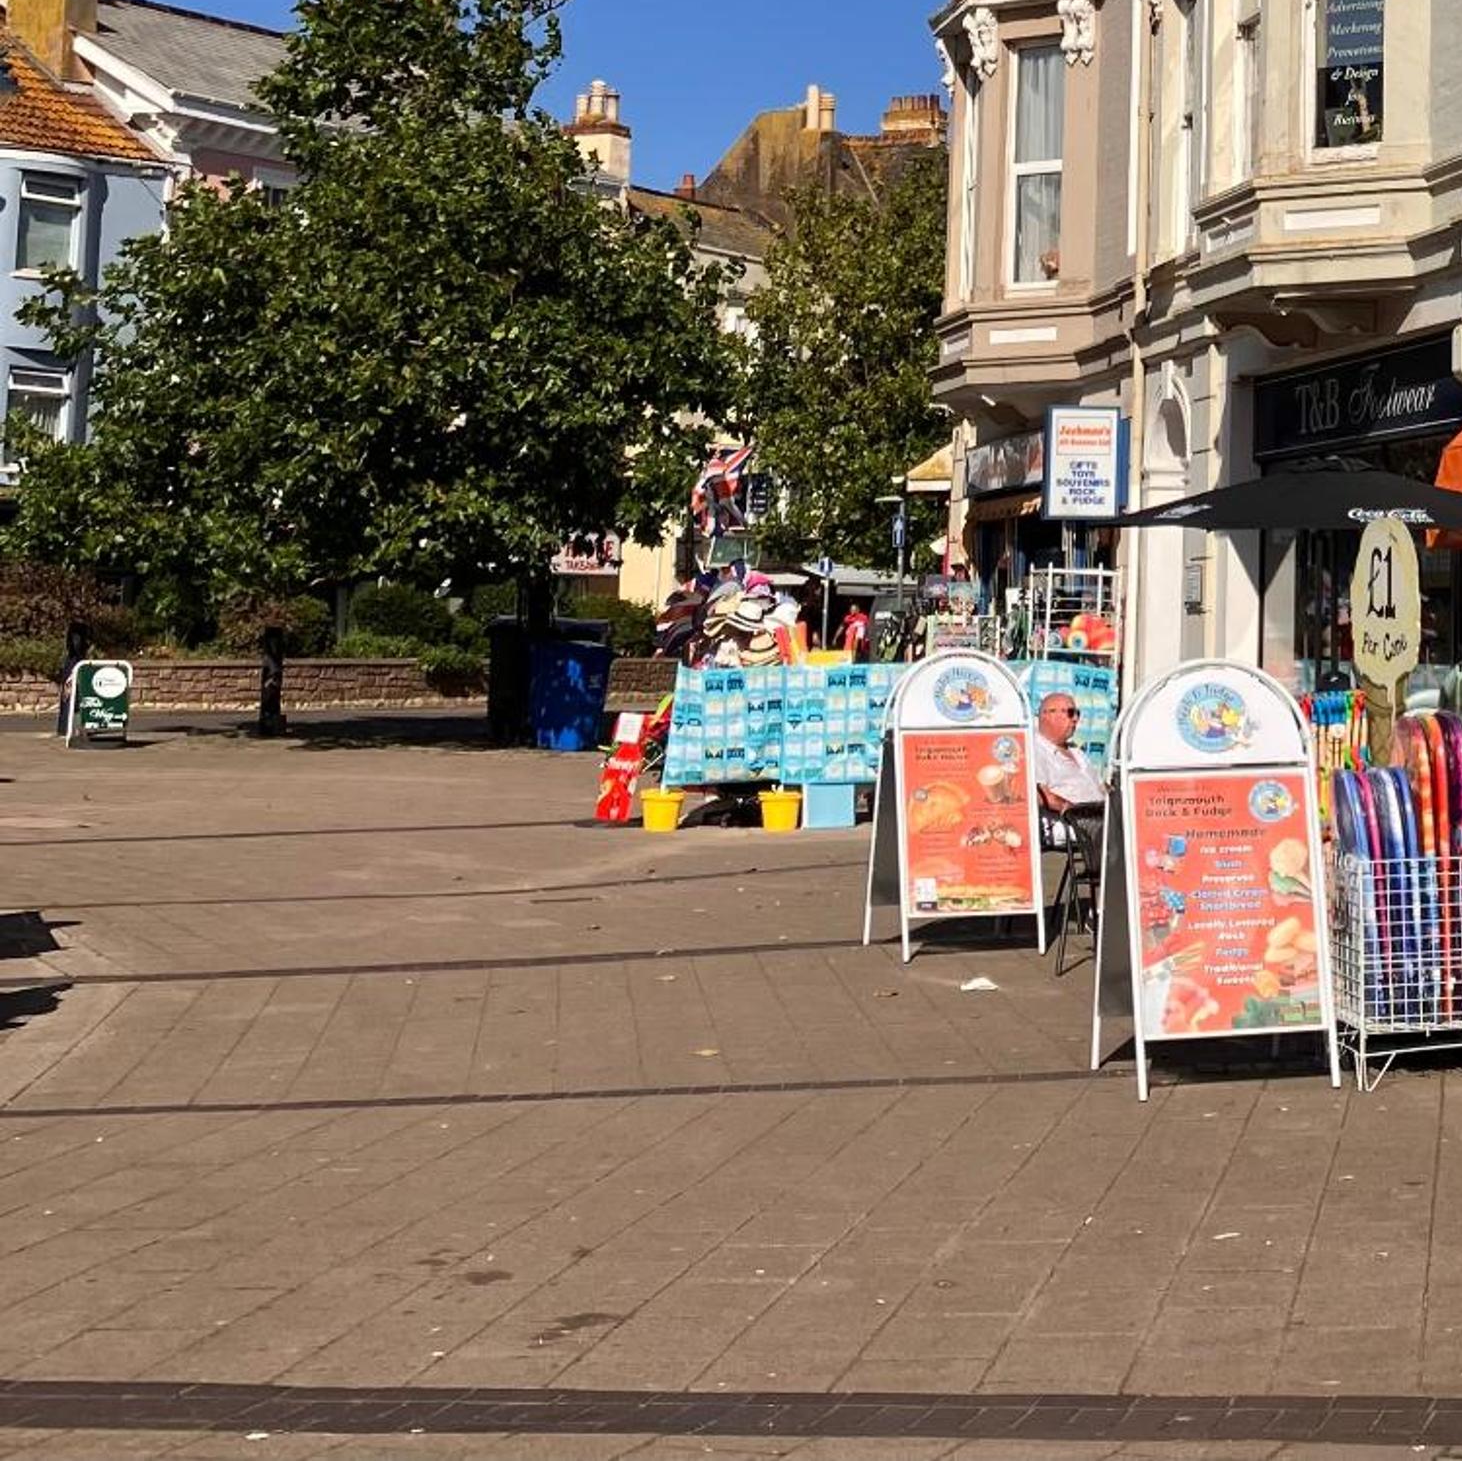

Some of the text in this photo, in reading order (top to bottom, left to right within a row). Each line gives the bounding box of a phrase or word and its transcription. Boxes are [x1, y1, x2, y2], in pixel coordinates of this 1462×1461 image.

[1330, 66, 1379, 83] & Design
[1296, 363, 1436, 435] T&B Footwear
[1069, 460, 1098, 470] GIFTS
[1071, 470, 1096, 479] TOYS
[1055, 479, 1111, 487] SOUVENIRS
[1061, 497, 1106, 505] & FUDGE
[1366, 546, 1397, 620] £1
[1361, 632, 1379, 656] Per
[1149, 794, 1225, 807] Teignmouth
[1145, 807, 1178, 818] Rock
[1193, 805, 1233, 817] Fudge
[1185, 827, 1266, 839] Homemade
